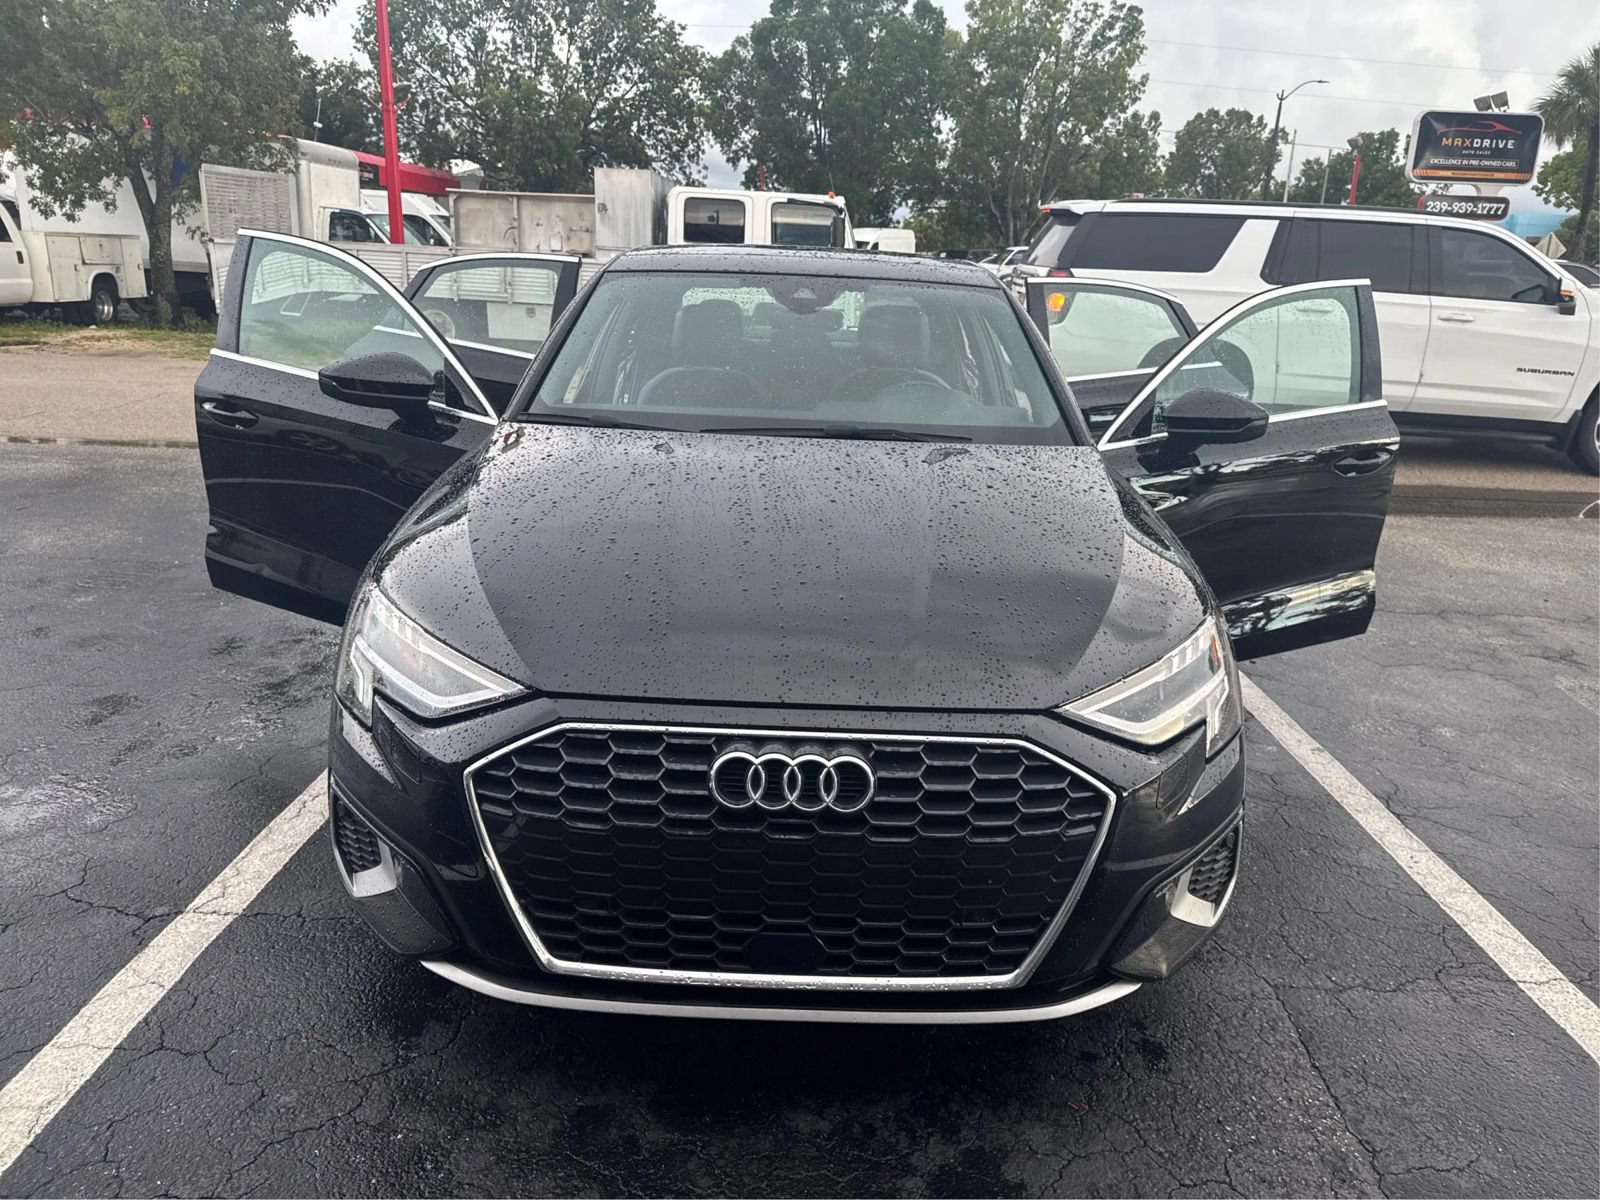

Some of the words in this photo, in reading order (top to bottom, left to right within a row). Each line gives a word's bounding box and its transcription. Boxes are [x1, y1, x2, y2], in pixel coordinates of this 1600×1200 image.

[1441, 137, 1516, 149] MAXDRIVE
[1426, 201, 1506, 215] 239-939-1777
[1516, 367, 1575, 377] SUBURBAN
